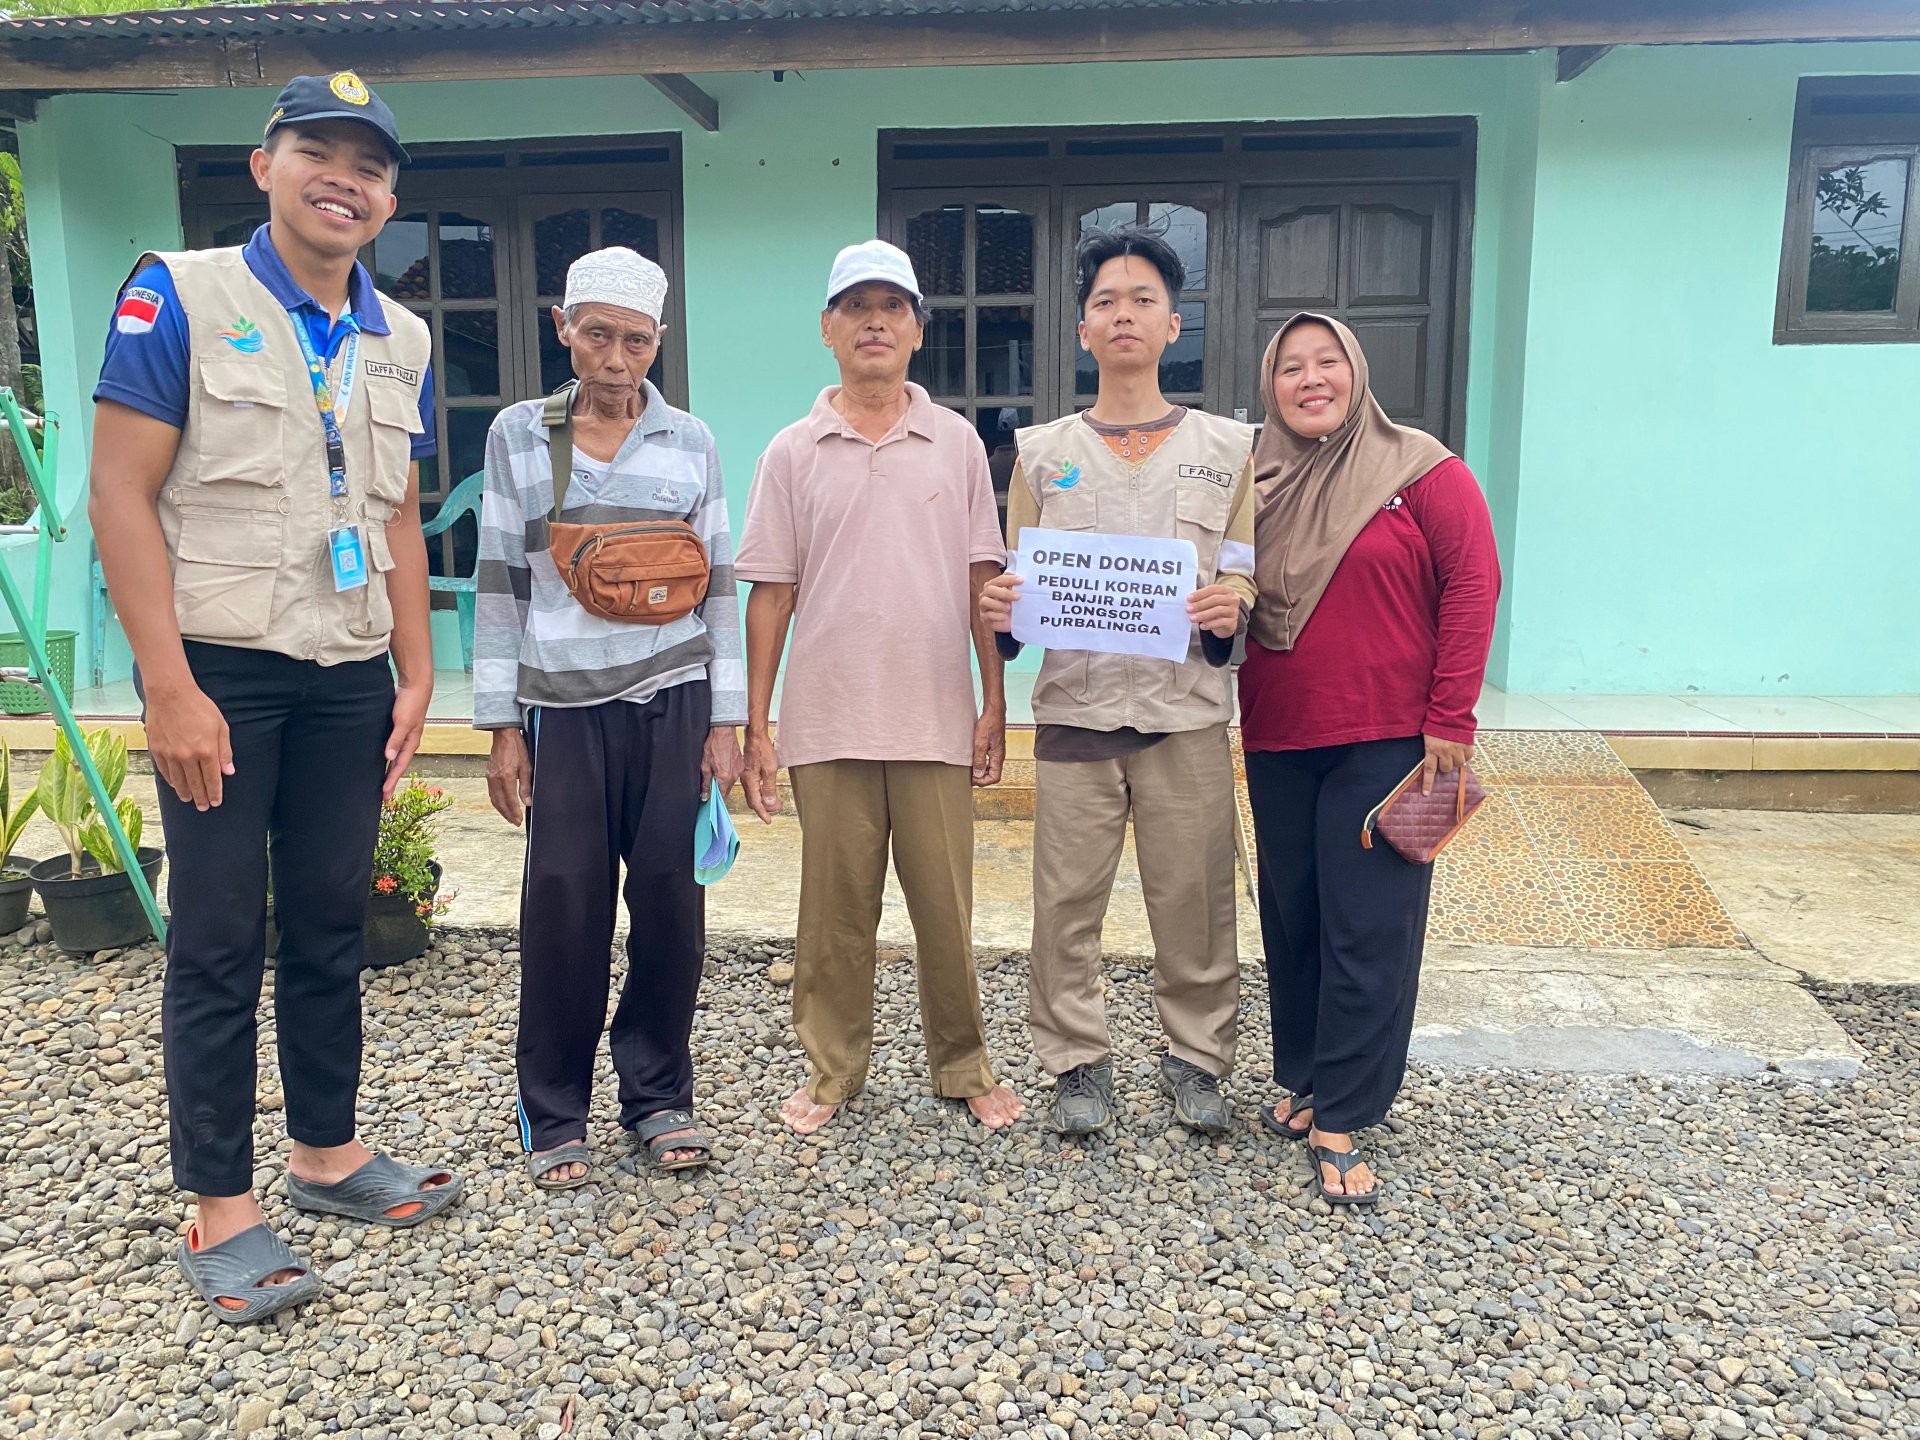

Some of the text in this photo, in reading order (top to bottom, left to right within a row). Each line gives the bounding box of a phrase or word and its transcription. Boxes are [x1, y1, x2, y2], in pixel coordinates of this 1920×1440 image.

[304, 342, 316, 361] 2026
[369, 363, 394, 376] ZAFFA
[1189, 468, 1222, 482] FARIS
[1032, 550, 1183, 576] OPEN DONASI
[1038, 575, 1178, 597] PEDULI KORBAN
[1051, 591, 1155, 609] BANJIR DAN
[1061, 605, 1143, 621] LONGSOR
[1040, 616, 1161, 635] PURBALINGGA
